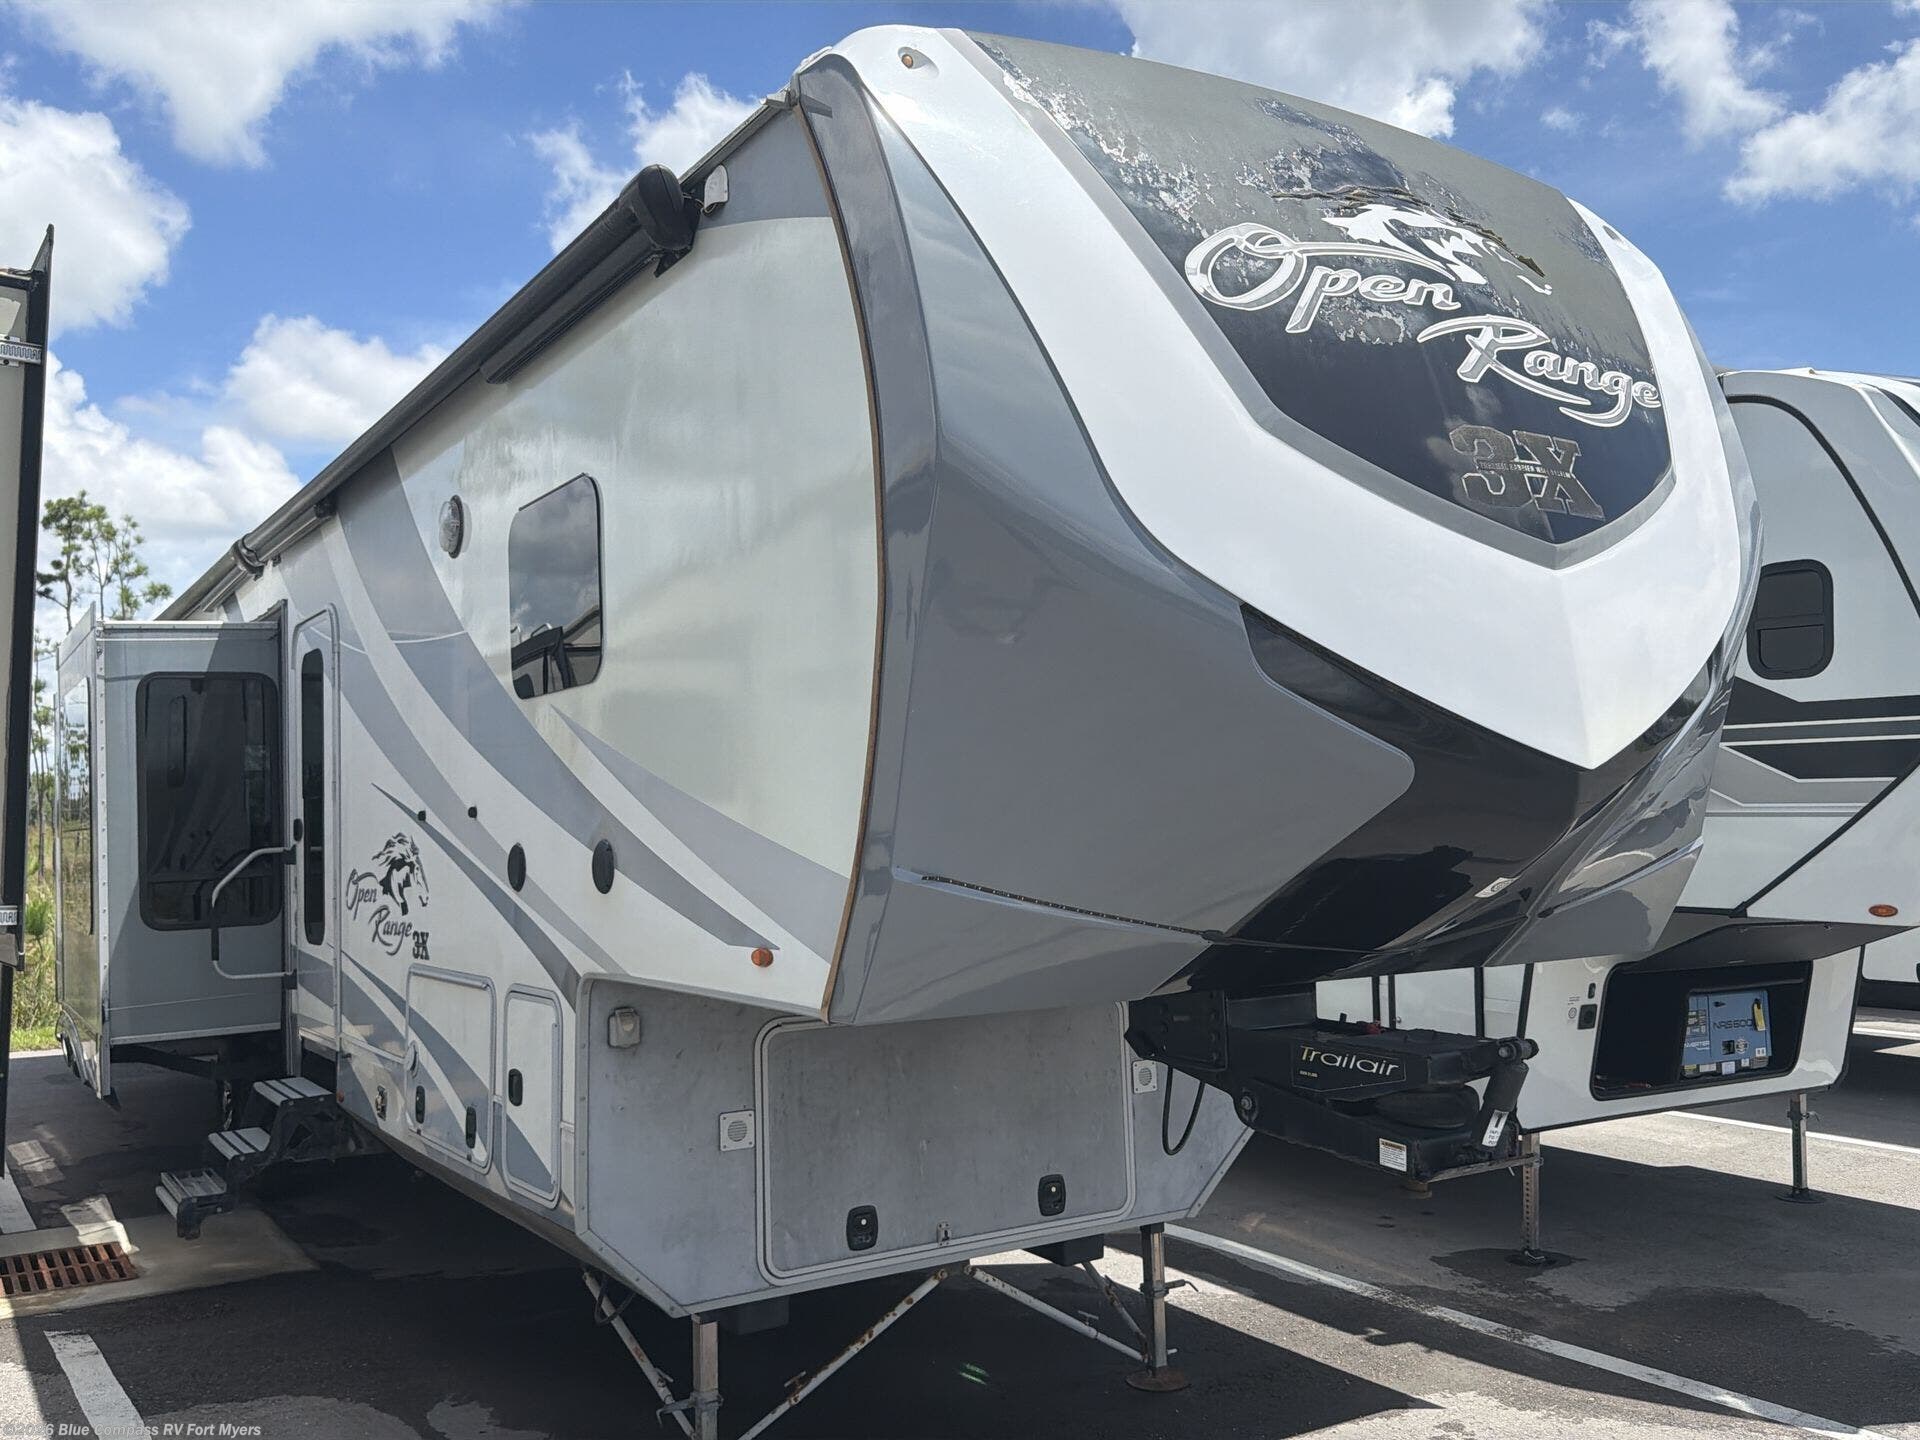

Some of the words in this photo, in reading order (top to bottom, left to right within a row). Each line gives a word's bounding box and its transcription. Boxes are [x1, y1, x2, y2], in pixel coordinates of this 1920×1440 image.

[1184, 222, 1461, 333] Open
[1417, 314, 1662, 427] Range
[1449, 424, 1605, 521] 3X
[346, 868, 378, 921] Open
[368, 904, 413, 956] Range
[412, 930, 430, 960] 3X
[1300, 1045, 1399, 1076] Trailair
